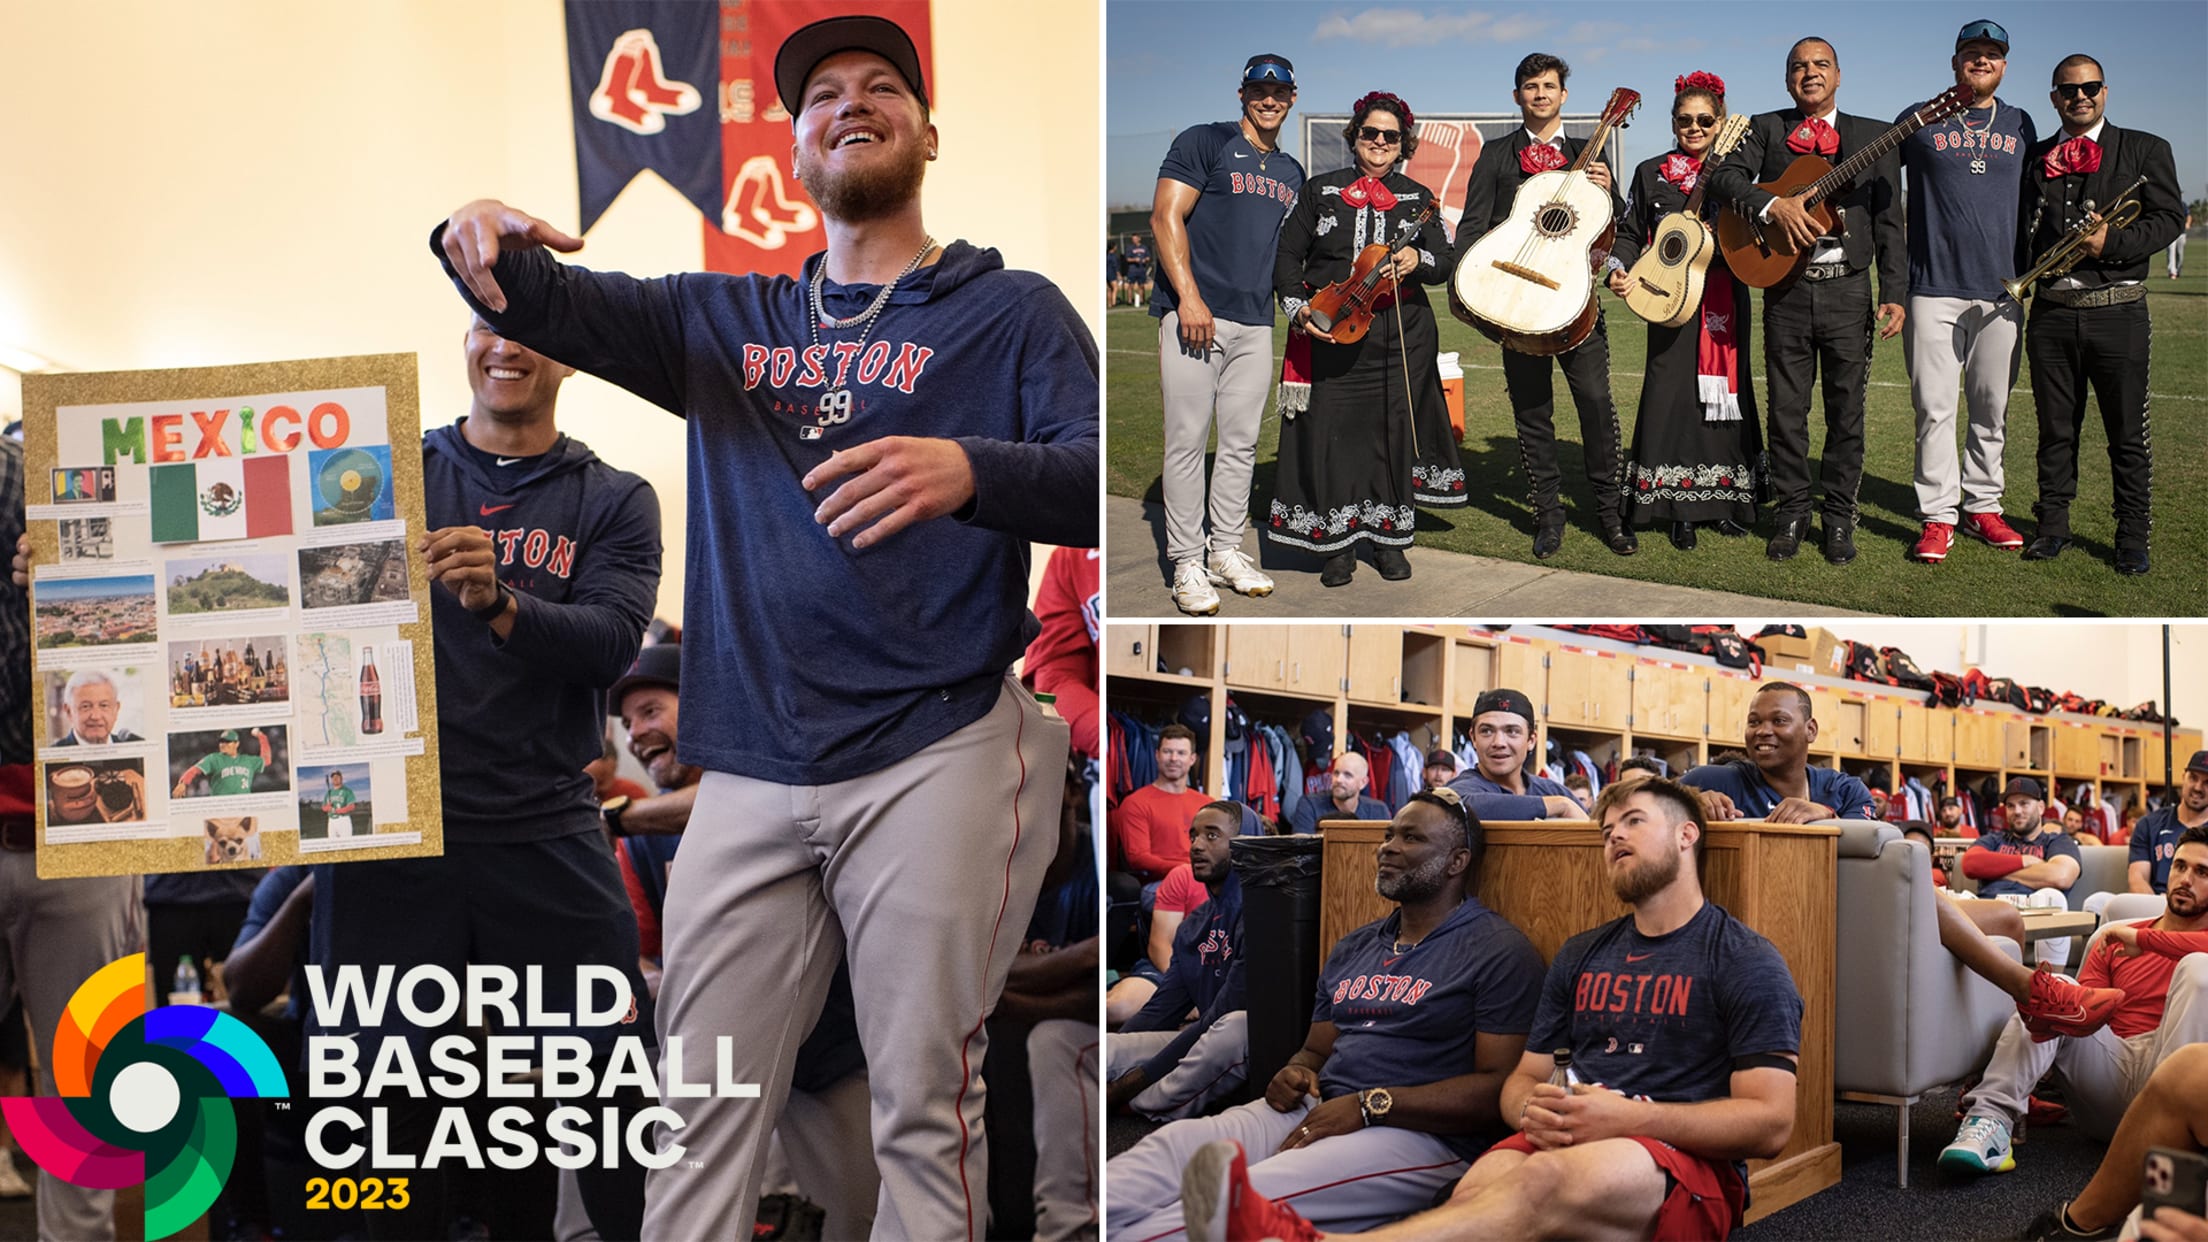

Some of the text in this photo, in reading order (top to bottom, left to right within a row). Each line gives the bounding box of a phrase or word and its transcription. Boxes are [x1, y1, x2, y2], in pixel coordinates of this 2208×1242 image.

[1933, 130, 2017, 155] BOSTON
[1969, 160, 1986, 174] 99
[743, 341, 934, 393] BOSTON
[818, 390, 851, 427] 99
[482, 527, 577, 578] TON
[1333, 974, 1432, 1005] BOSTON
[1575, 971, 1693, 1016] BOSTON
